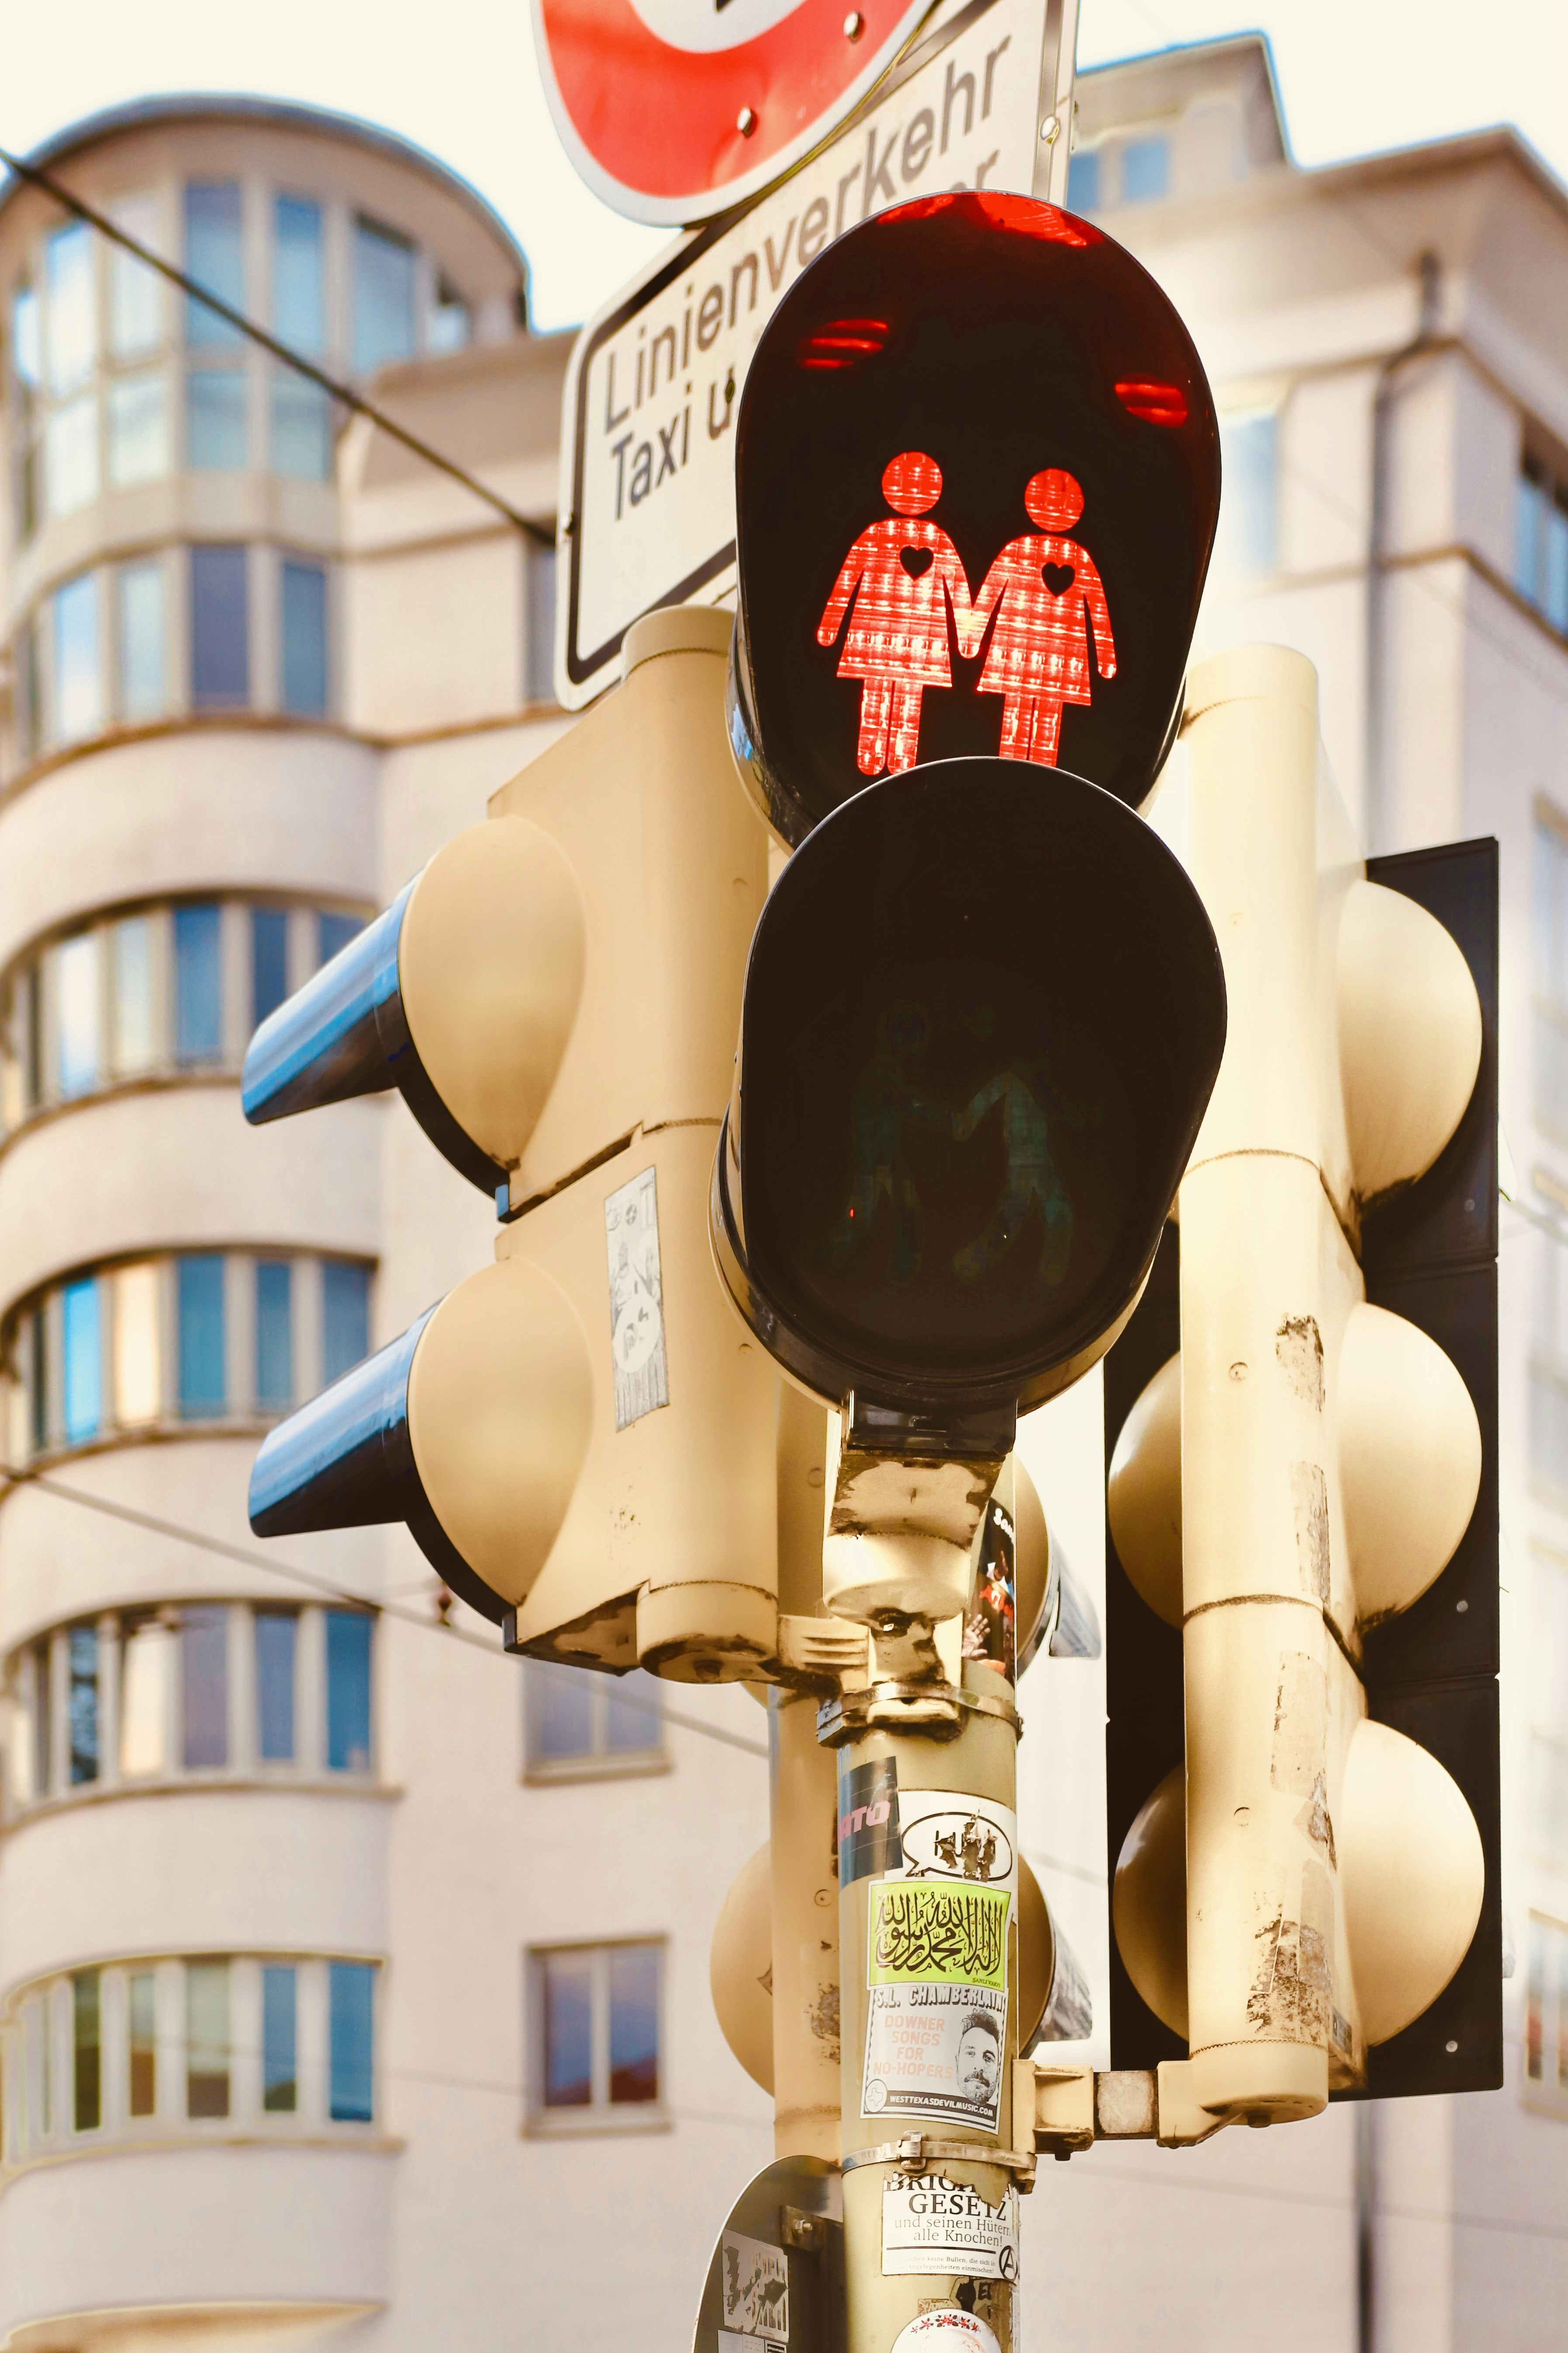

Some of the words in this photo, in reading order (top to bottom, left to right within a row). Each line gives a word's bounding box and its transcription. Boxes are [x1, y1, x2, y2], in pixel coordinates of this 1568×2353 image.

[605, 34, 1012, 434] Linienverkehr
[611, 381, 692, 521] Taxi
[875, 1987, 901, 2008] S.L.
[908, 1986, 1005, 2013] CHAMBERLAIN
[884, 2015, 945, 2031] DOWNER
[891, 2031, 940, 2046] SONGS
[897, 2047, 924, 2060] FOR
[874, 2062, 953, 2080] NO-HOPERS
[890, 2095, 993, 2117] WESTTEXASDEVILMUSIC.COM
[895, 2216, 920, 2228] und
[926, 2216, 972, 2229] seinen
[914, 2229, 939, 2241] alle
[945, 2230, 1002, 2247] Knochen!
